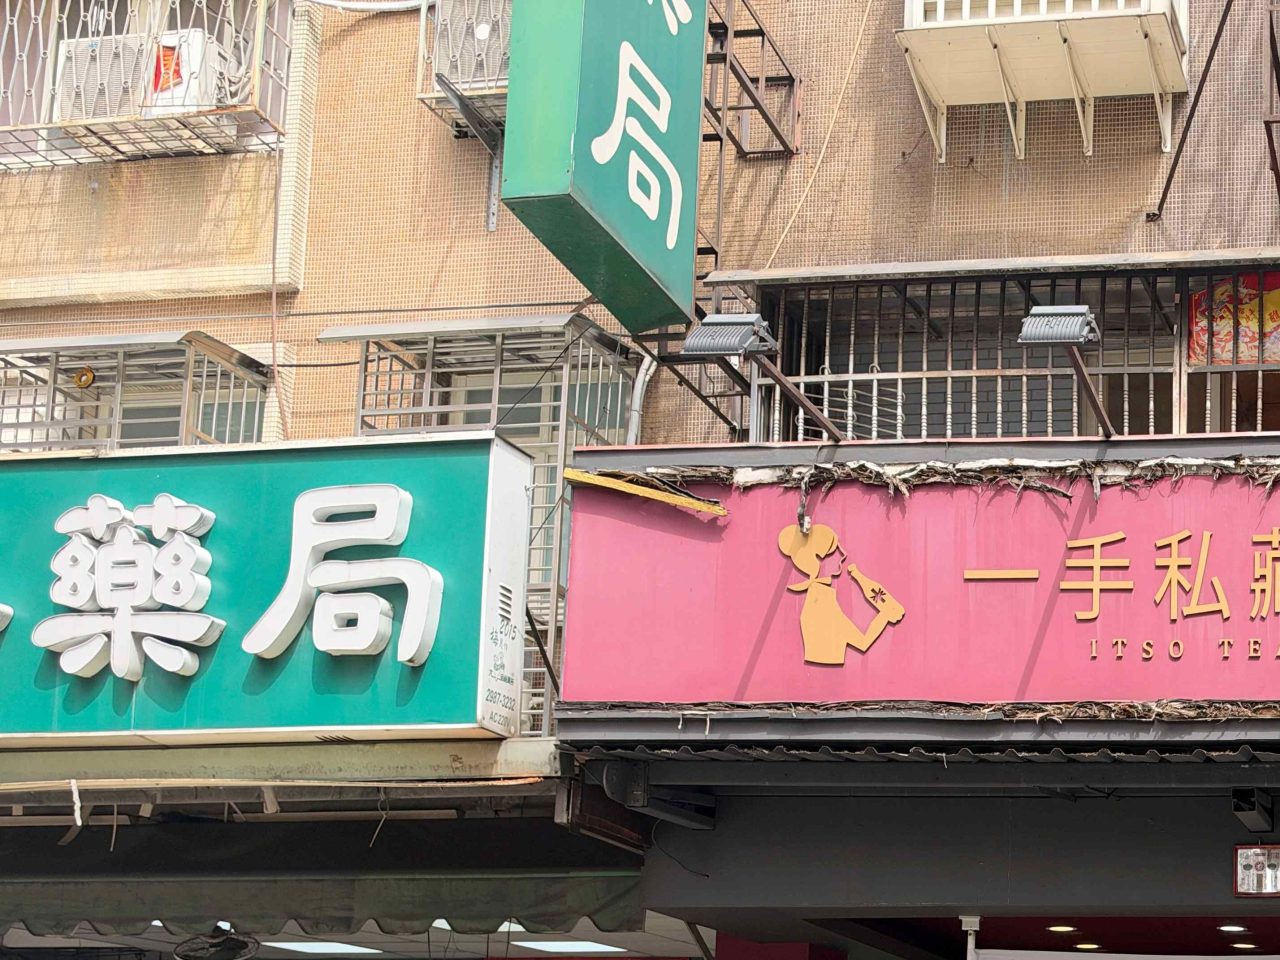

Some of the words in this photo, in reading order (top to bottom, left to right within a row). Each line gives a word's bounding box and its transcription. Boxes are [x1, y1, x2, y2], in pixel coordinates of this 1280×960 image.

[591, 0, 693, 250] 局
[0, 483, 445, 682] 藥局
[1089, 638, 1186, 661] ITSO
